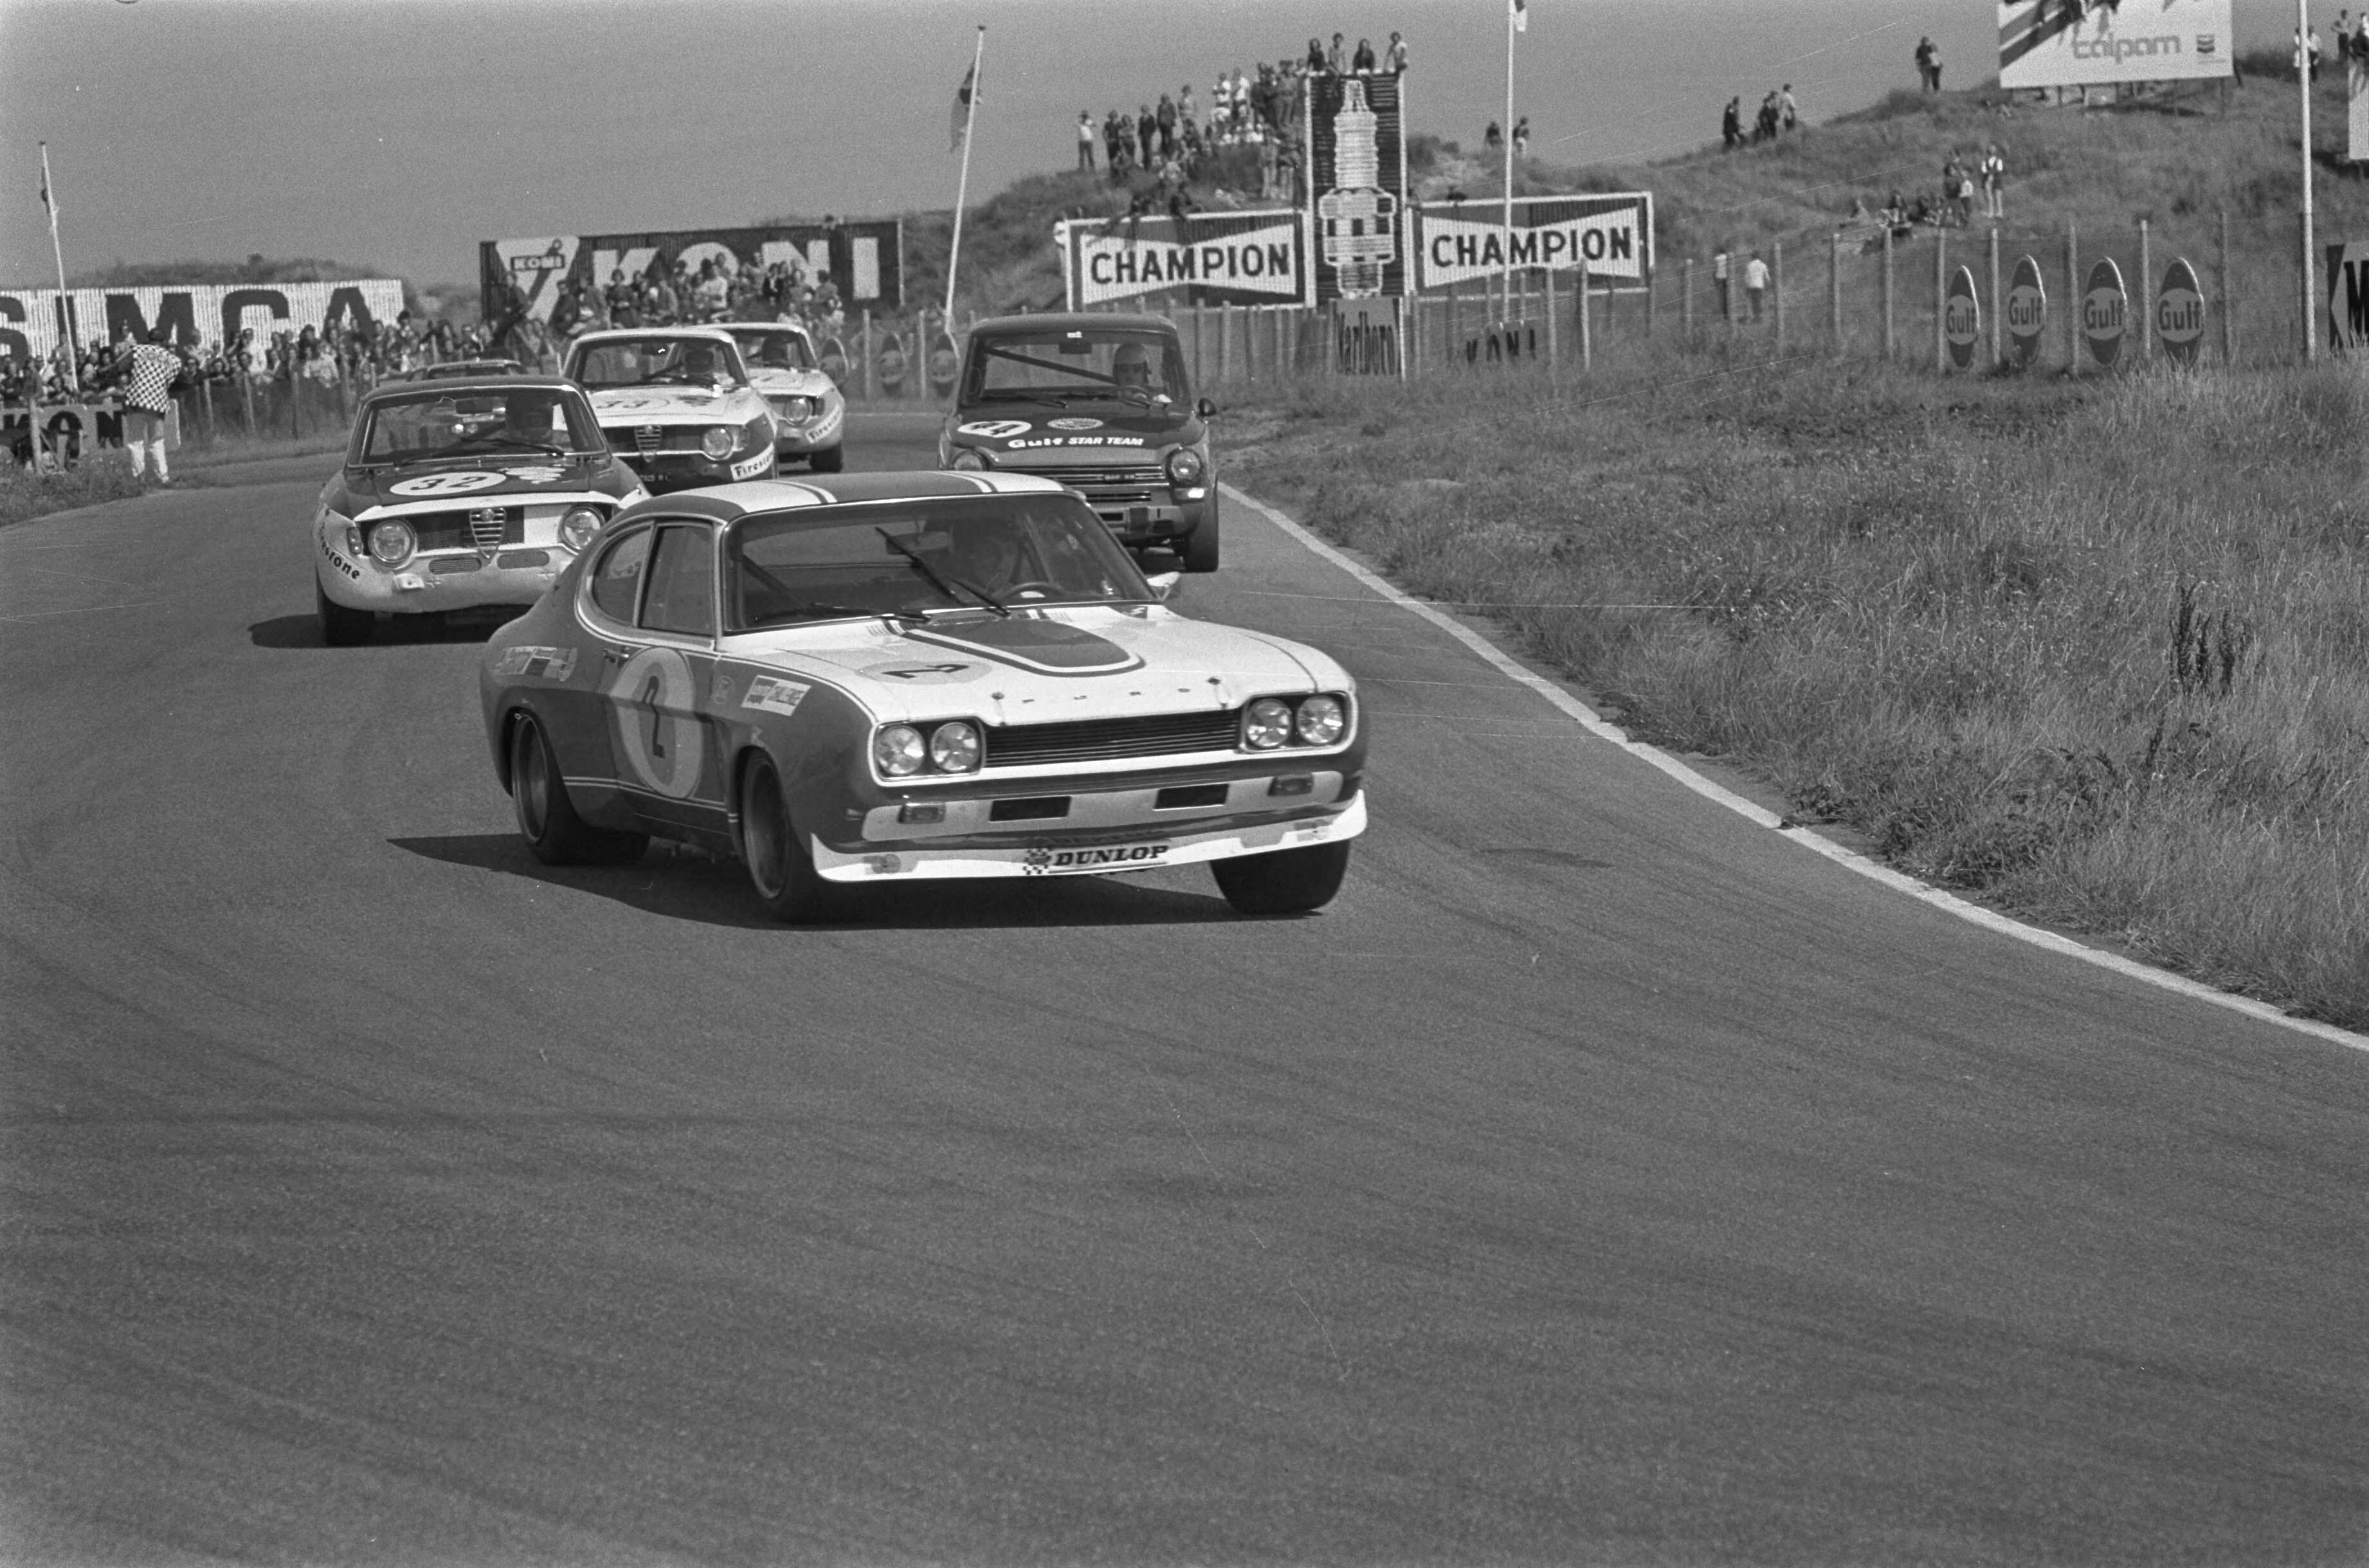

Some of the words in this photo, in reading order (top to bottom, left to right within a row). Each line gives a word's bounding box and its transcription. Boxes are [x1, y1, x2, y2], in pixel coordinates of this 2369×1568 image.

[1431, 225, 1631, 267] CHAMPION
[1091, 242, 1290, 284] CHAMPION
[1947, 305, 1975, 334] Gulf
[2008, 296, 2042, 326] Gulf
[2084, 298, 2122, 330] Gulf
[2158, 300, 2201, 330] Gulf
[1008, 437, 1063, 448] Gulf
[1067, 437, 1103, 446] STAR
[1107, 437, 1145, 446] TEAM
[410, 476, 488, 491] 32
[881, 663, 970, 679] 2
[643, 675, 666, 759] 2
[1054, 845, 1169, 867] DUNLOP
